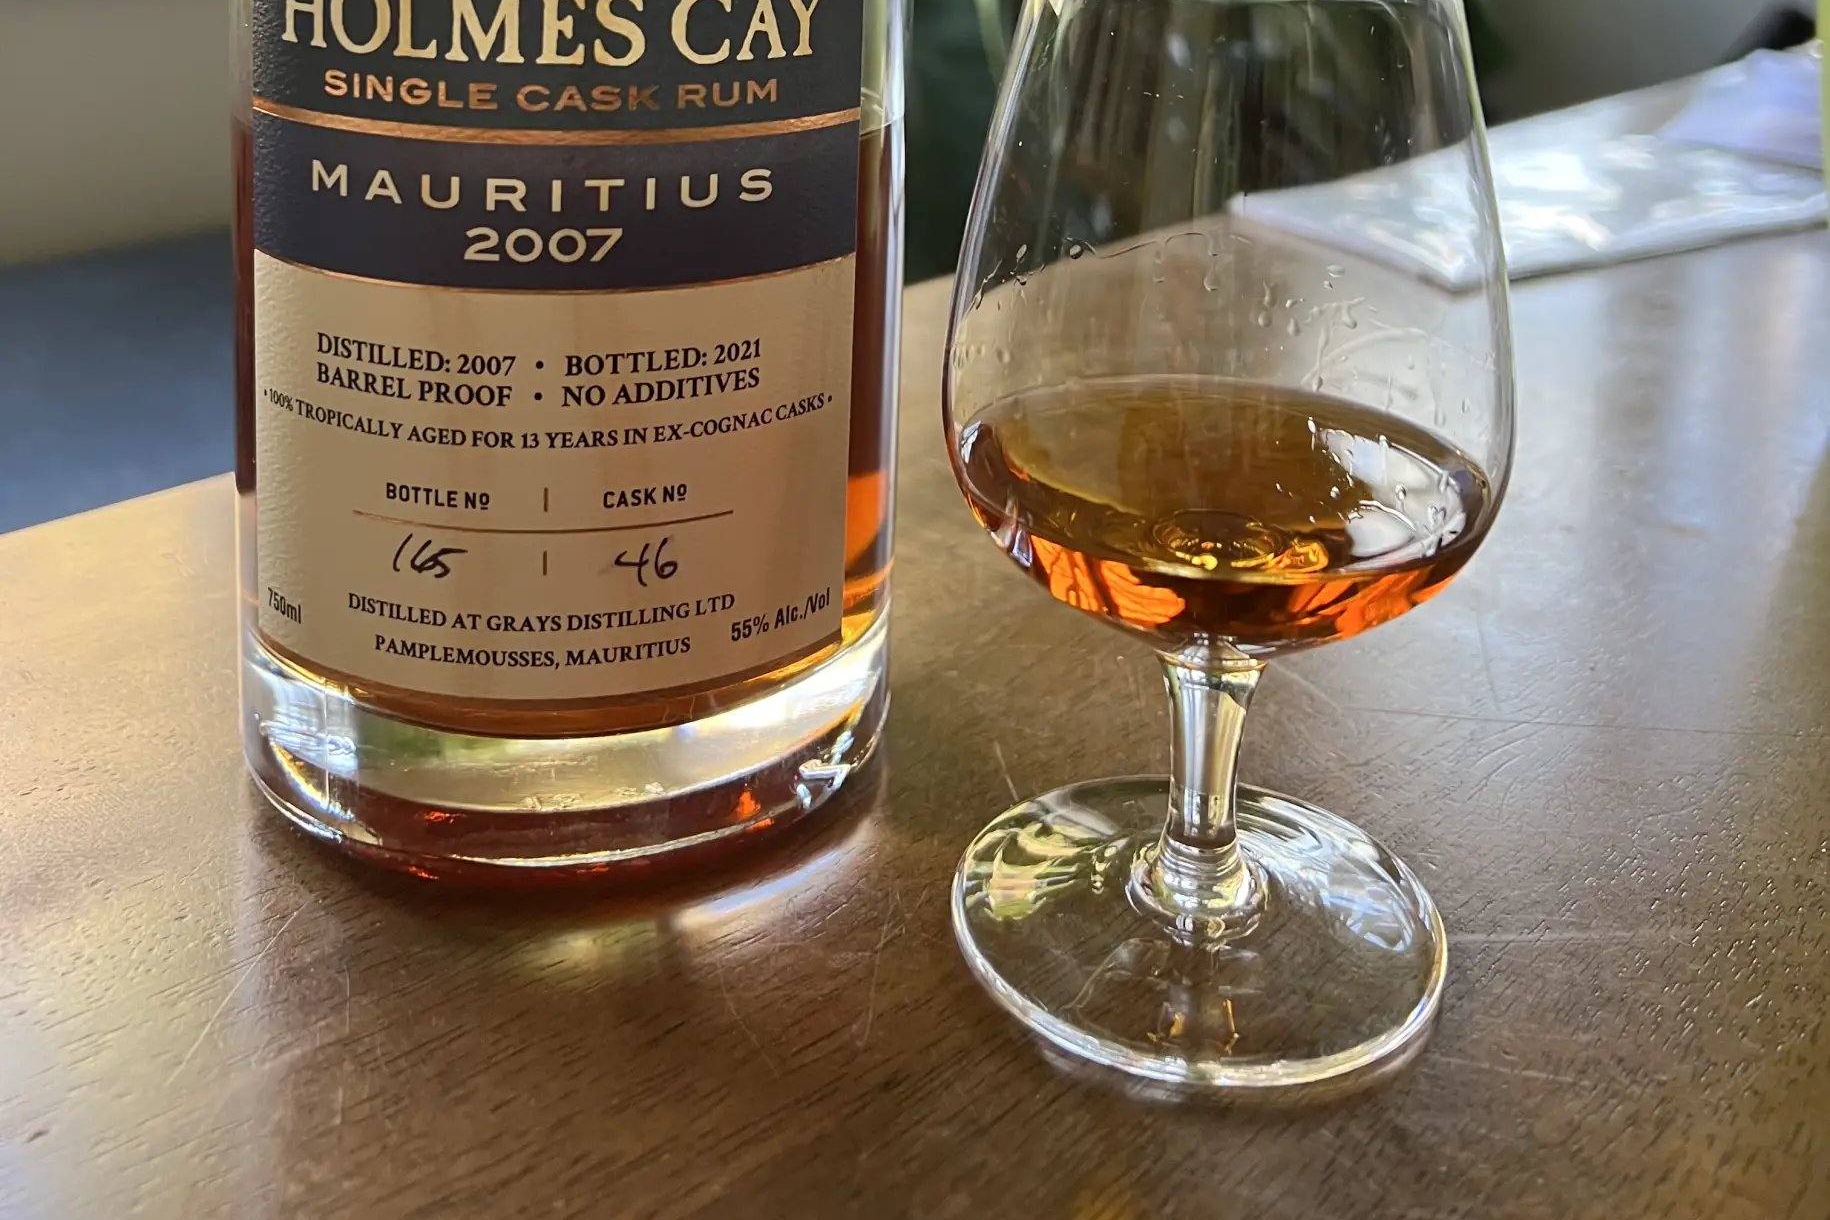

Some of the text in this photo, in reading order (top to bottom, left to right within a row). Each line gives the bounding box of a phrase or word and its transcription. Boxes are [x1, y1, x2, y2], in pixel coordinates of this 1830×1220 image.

[324, 68, 778, 112] SINGLE CASK RUM
[311, 159, 775, 213] MAURITIUS
[463, 227, 624, 264] 2007
[317, 332, 516, 377] DISTILLED: 2007
[565, 338, 761, 377] BOTTLED: 2021
[317, 362, 513, 407] BARREL PROOF
[561, 367, 760, 408] NO ADDITIVES
[269, 388, 825, 449] 100% TROPICALLY AGED FOR 13 YEARS IN EX-COGNAC CASKS
[386, 483, 458, 508] BOTTLE
[603, 489, 657, 509] CASK
[393, 533, 468, 578] 165
[613, 537, 678, 587] 46
[268, 587, 302, 624] 750ml
[348, 593, 735, 632] DISTILLED AT GRAYS DISTILLING LTD
[731, 615, 769, 642] 55%
[375, 634, 691, 670] PAMPLEMOUSSES, MAURITIUS
